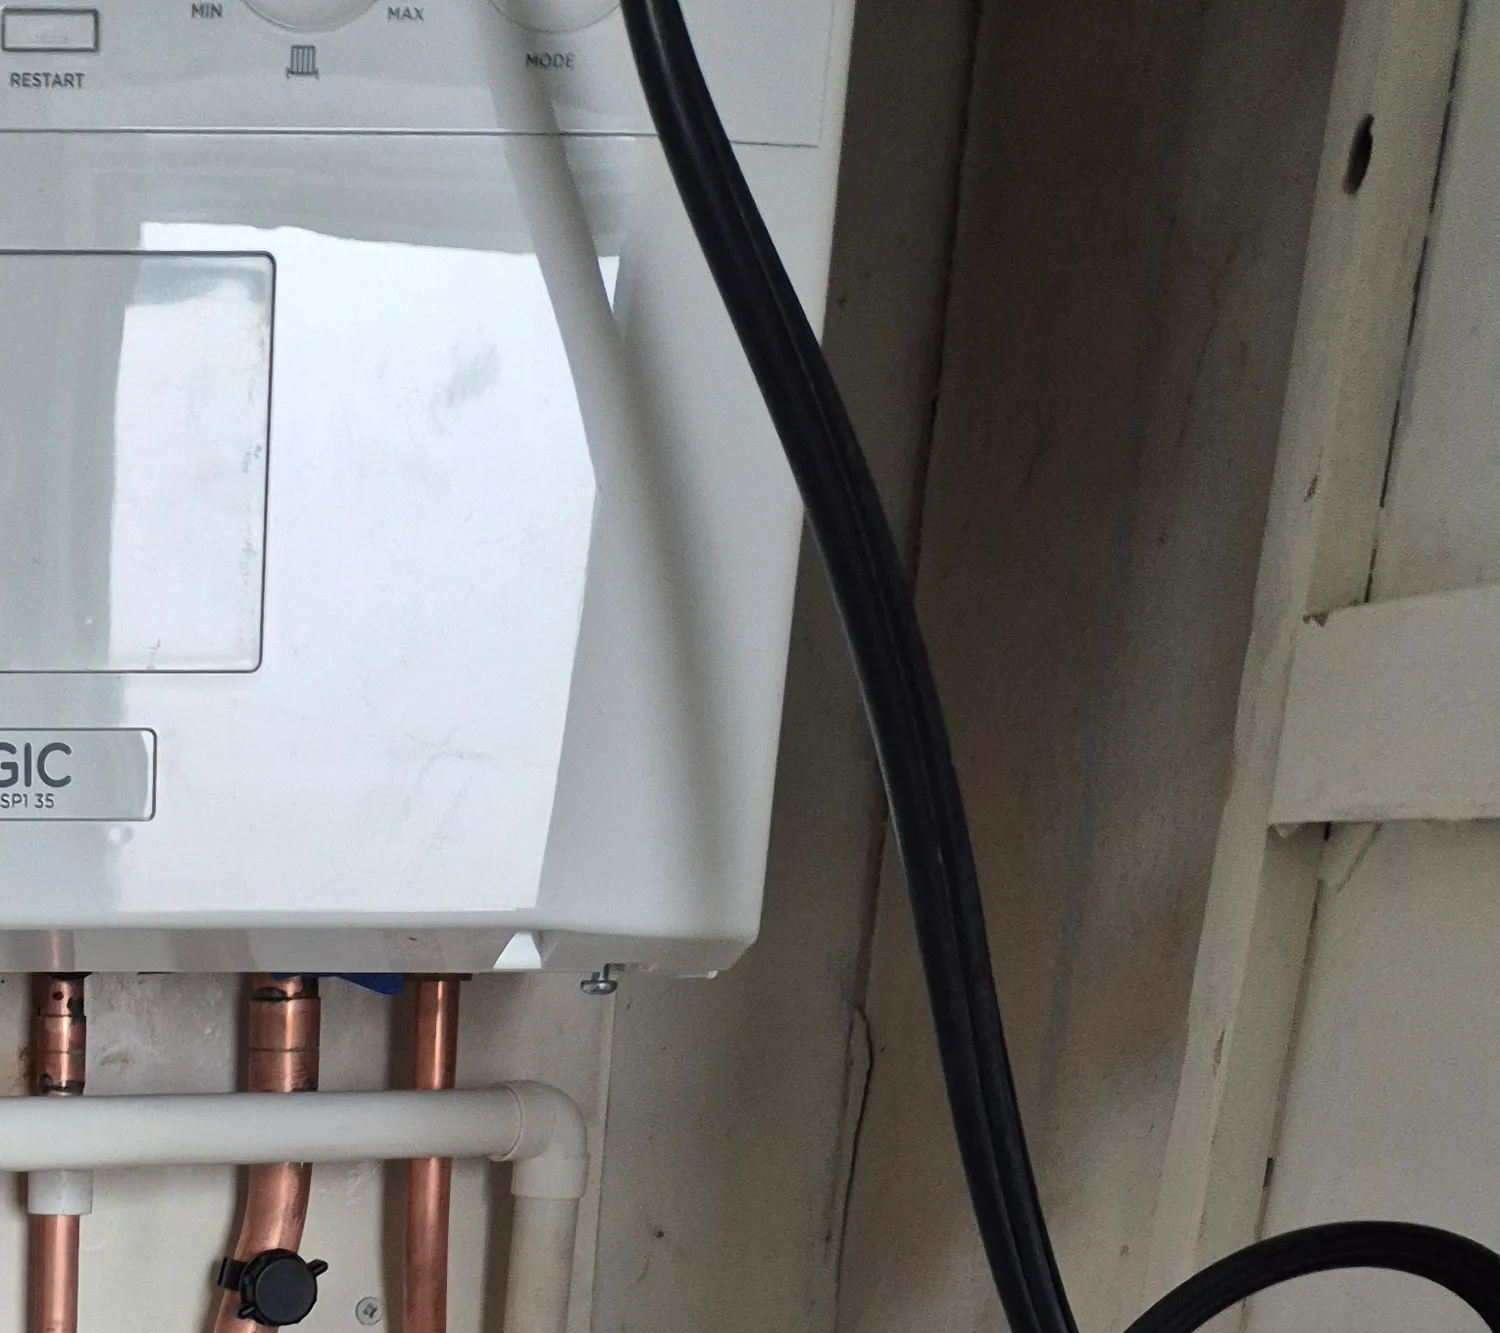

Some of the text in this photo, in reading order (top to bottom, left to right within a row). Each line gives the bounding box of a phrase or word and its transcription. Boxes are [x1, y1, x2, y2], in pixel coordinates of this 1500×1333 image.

[191, 3, 222, 20] MIN
[387, 5, 425, 22] MAX
[525, 52, 575, 70] MODE
[9, 72, 84, 89] RESTART
[34, 793, 55, 809] 35
